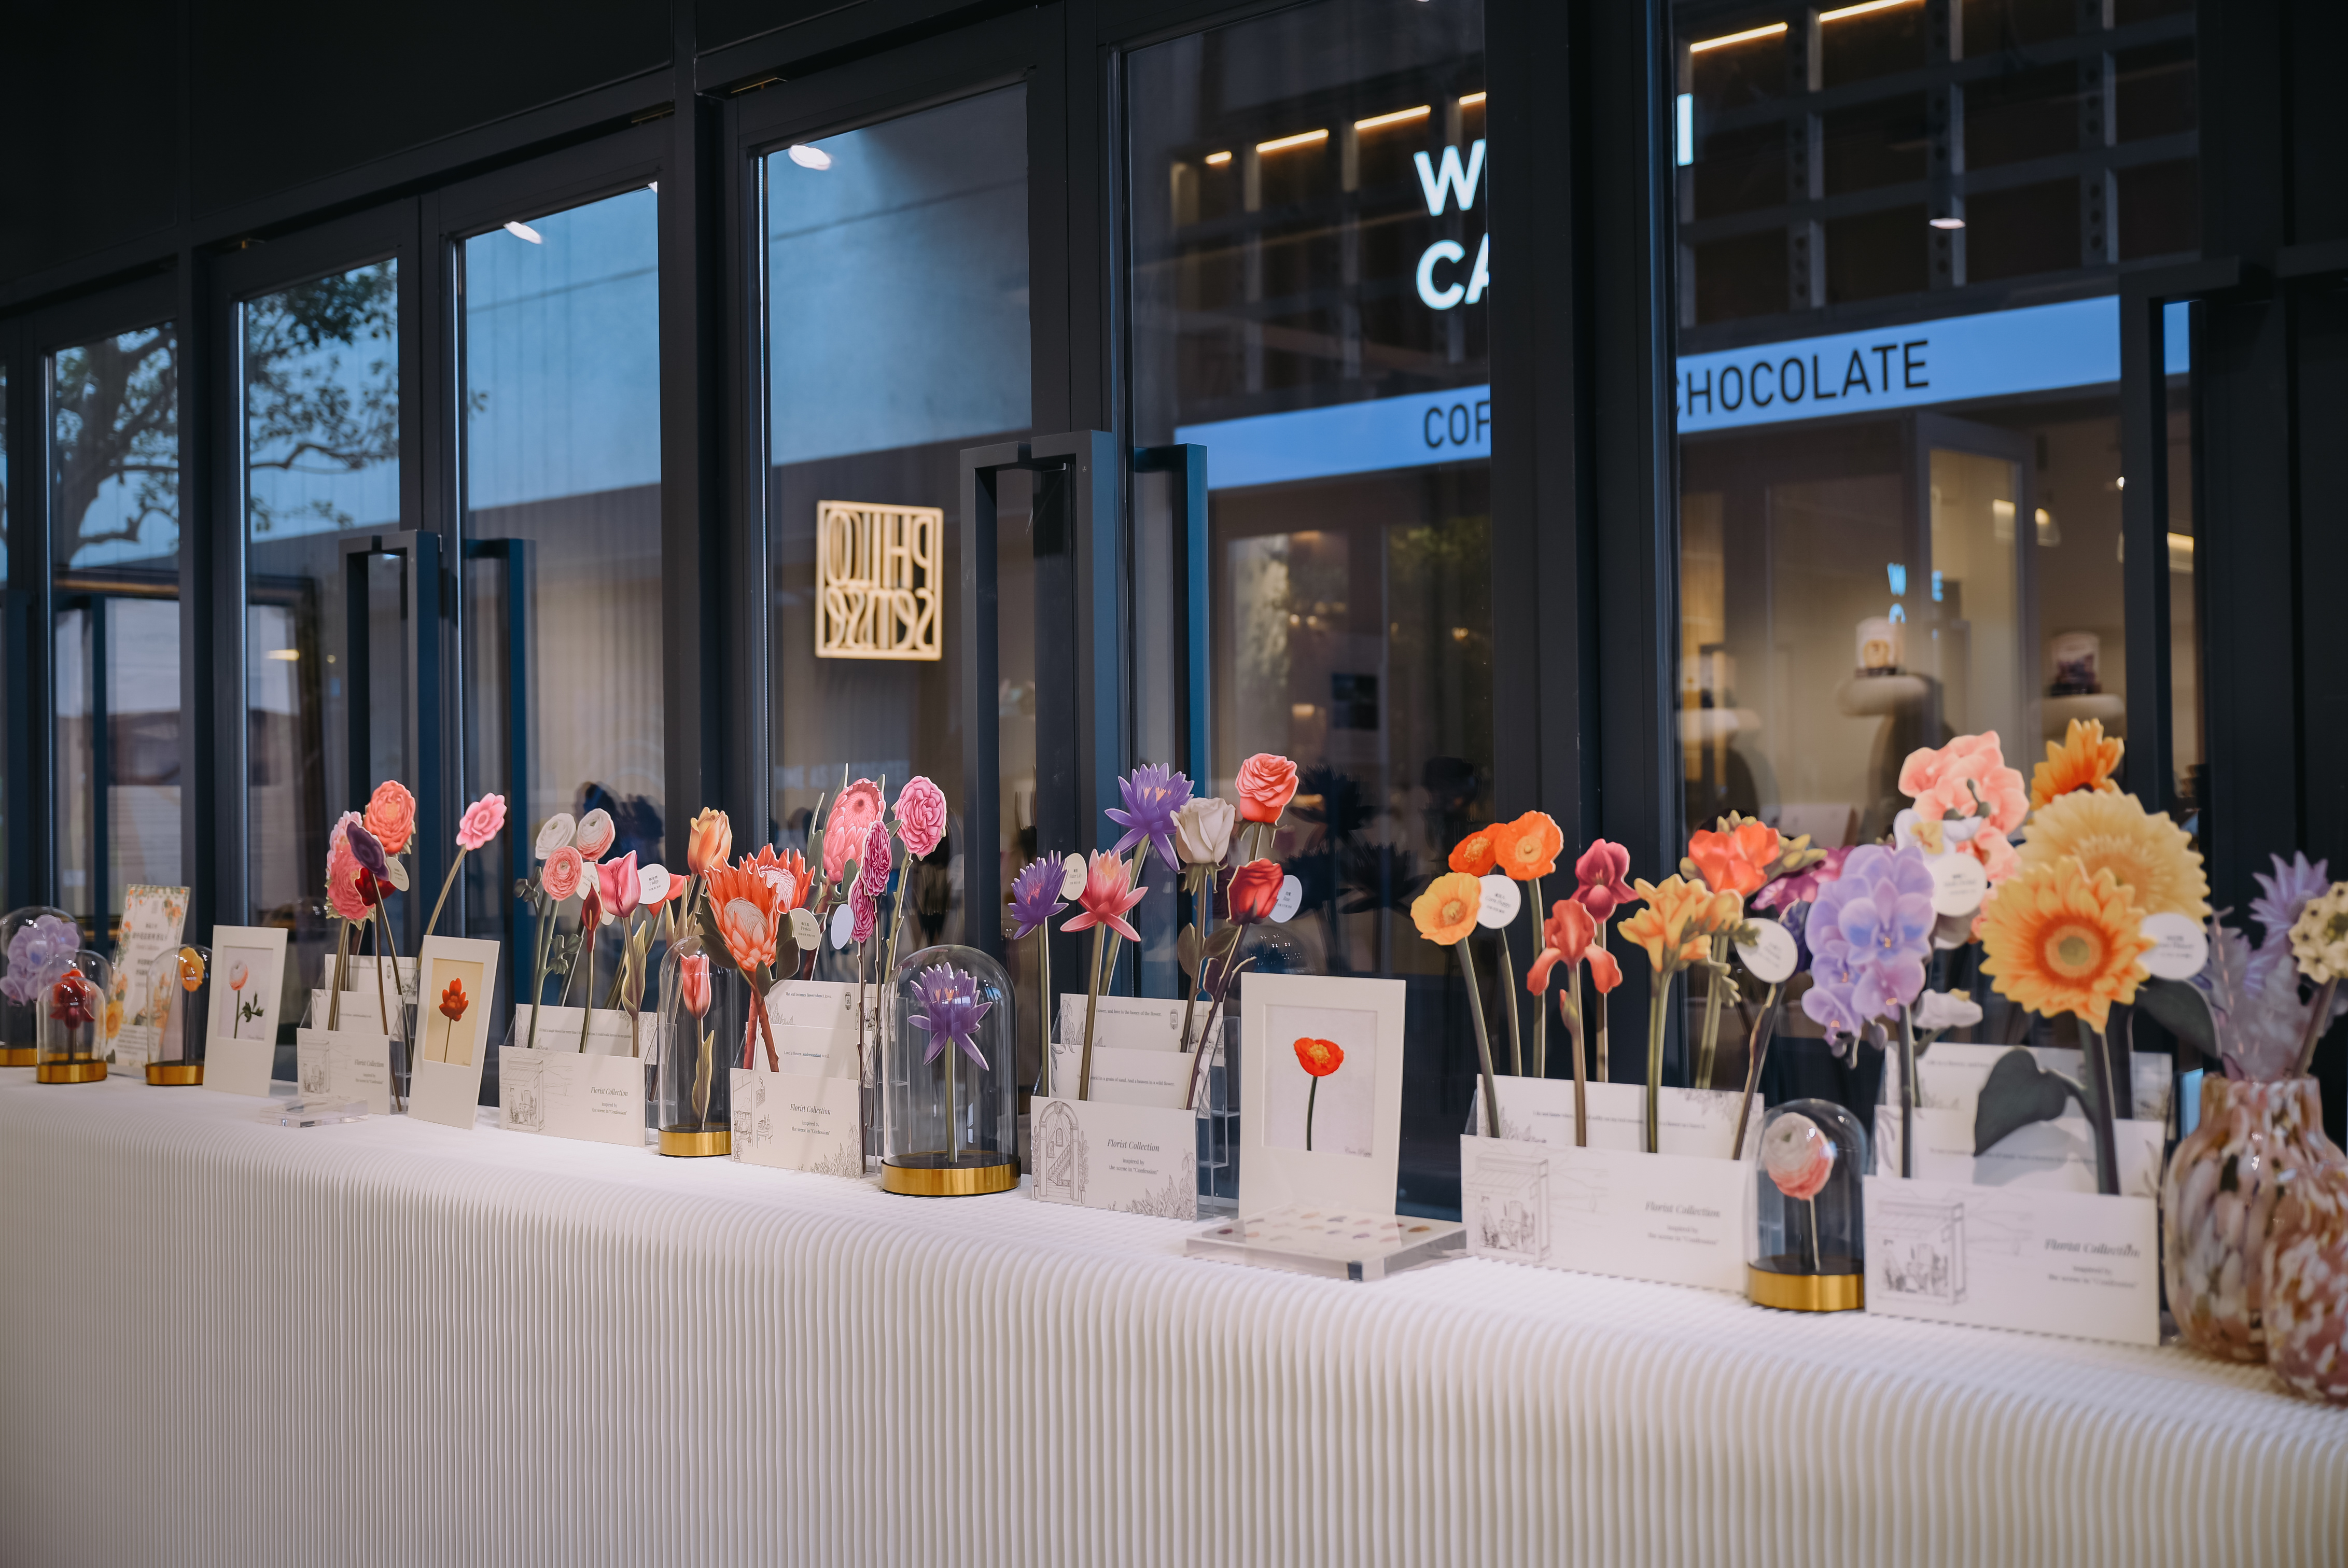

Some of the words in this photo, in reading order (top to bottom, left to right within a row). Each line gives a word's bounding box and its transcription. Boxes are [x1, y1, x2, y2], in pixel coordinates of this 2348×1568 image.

[1676, 339, 1930, 417] HOCOLATE
[606, 1088, 628, 1097] Collection
[790, 1103, 806, 1112] Florist
[807, 1105, 831, 1115] Collection
[1108, 1139, 1127, 1149] Florist
[1129, 1141, 1160, 1152] Collection
[1645, 1200, 1673, 1213] Florist
[1675, 1203, 1721, 1218] Collection
